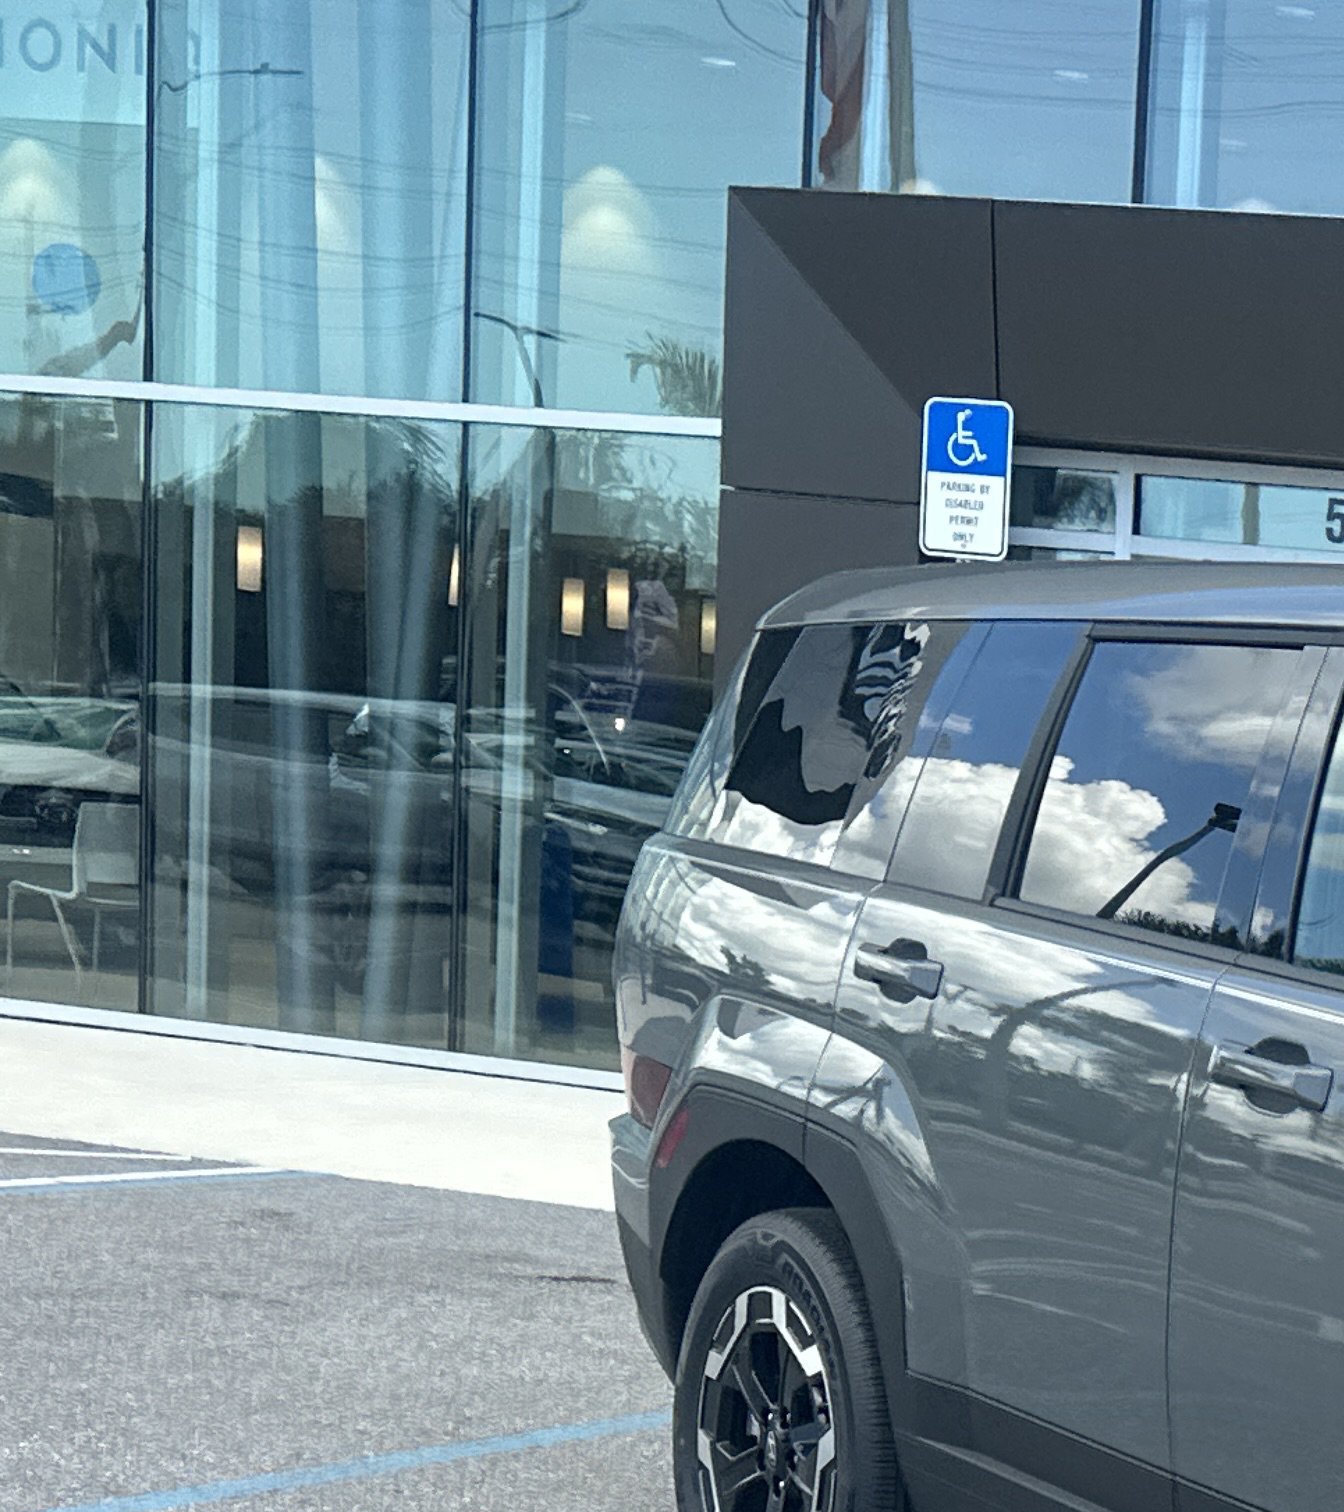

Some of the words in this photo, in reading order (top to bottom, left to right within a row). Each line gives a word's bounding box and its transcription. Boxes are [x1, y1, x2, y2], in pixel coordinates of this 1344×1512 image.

[0, 17, 201, 76] ONI
[940, 481, 976, 493] PARKING
[979, 484, 991, 495] BY
[945, 498, 984, 511] DISABLED
[949, 515, 979, 527] PERMIT
[952, 531, 975, 543] ONLY
